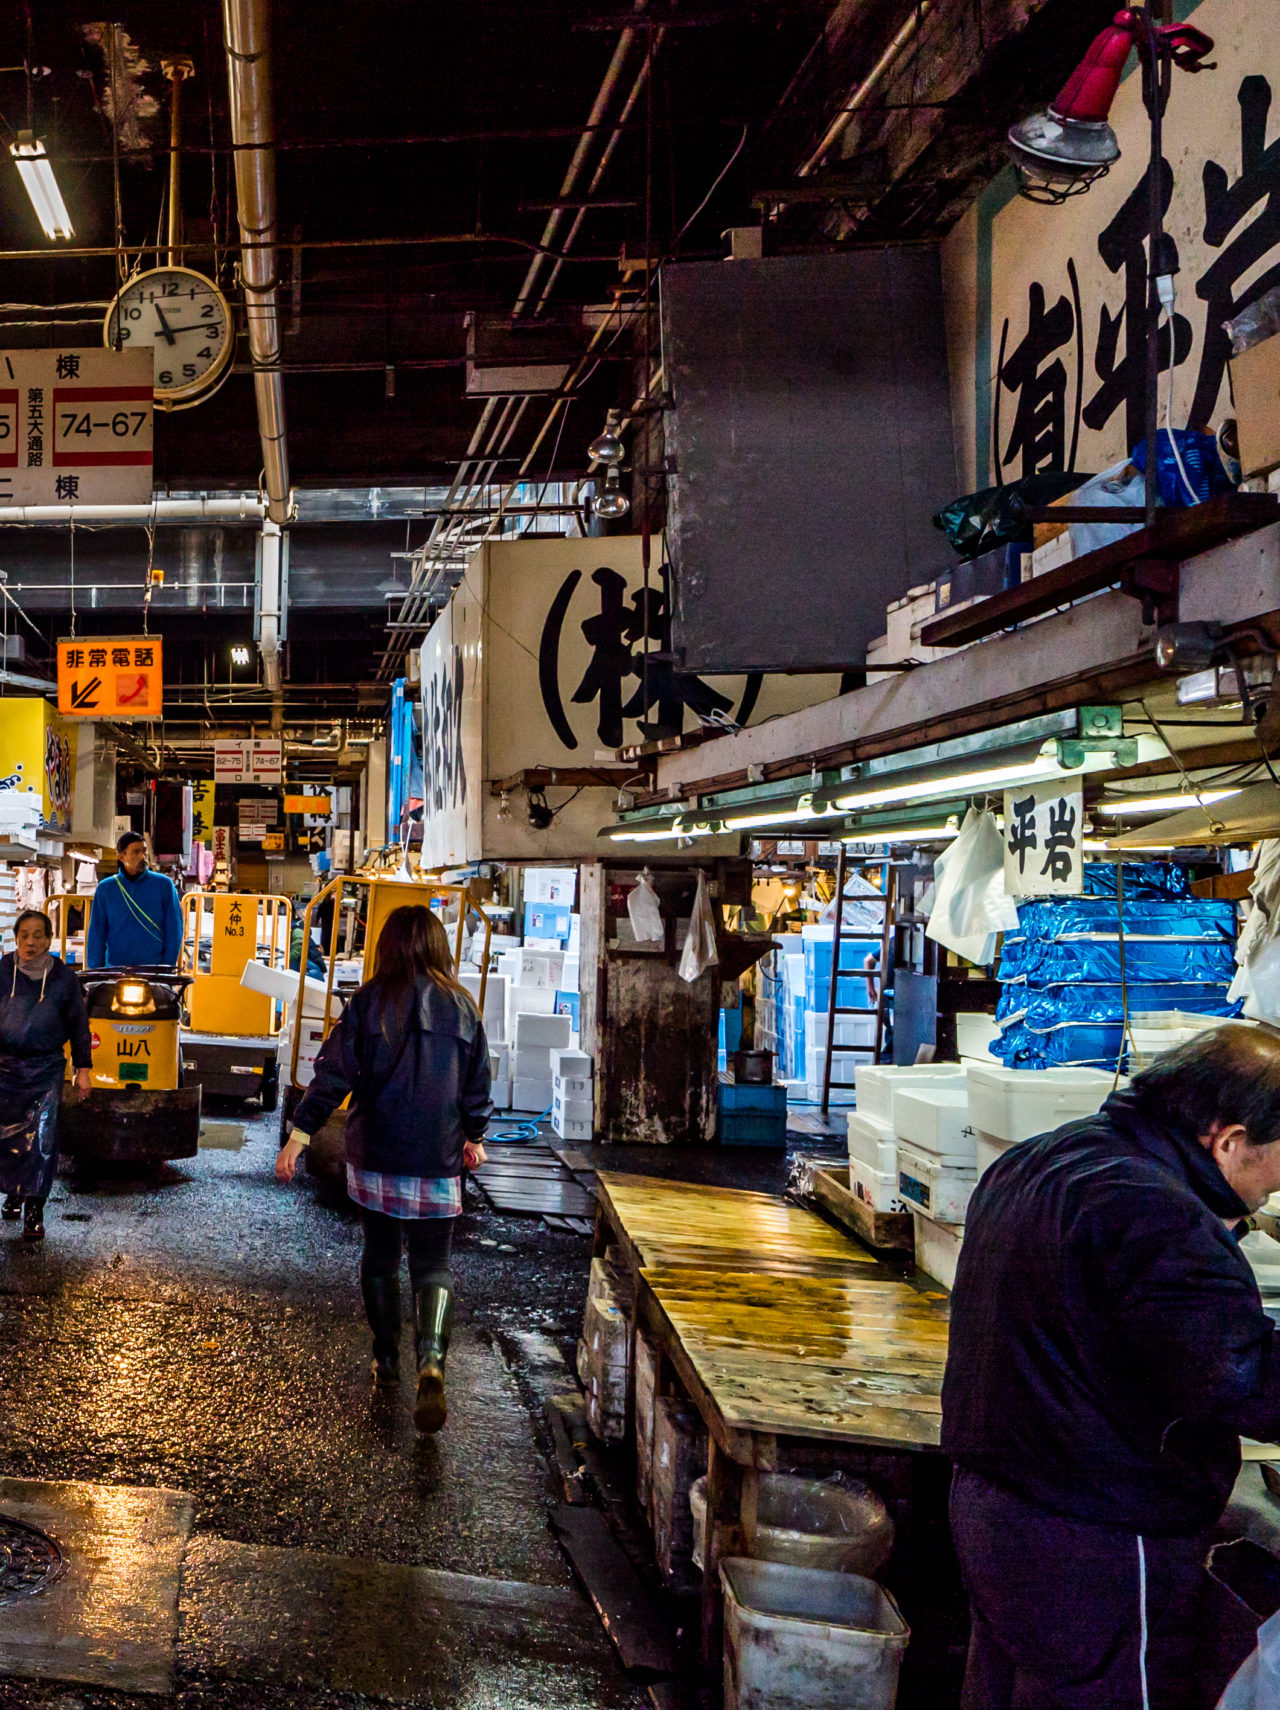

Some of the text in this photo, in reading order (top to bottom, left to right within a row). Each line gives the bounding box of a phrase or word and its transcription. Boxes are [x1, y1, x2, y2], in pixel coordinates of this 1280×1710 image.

[161, 282, 179, 296] 12
[123, 307, 142, 320] 10
[200, 304, 215, 318] 2
[205, 326, 219, 339] 3
[196, 346, 212, 359] 4
[158, 370, 173, 384] 6
[182, 363, 196, 377] 5
[27, 387, 44, 467] 第五大通路
[60, 412, 147, 438] 74-67
[66, 647, 154, 669] 非常電話
[1008, 794, 1076, 883] 平岩
[224, 926, 245, 937] No.3
[117, 1039, 151, 1057] 山八
